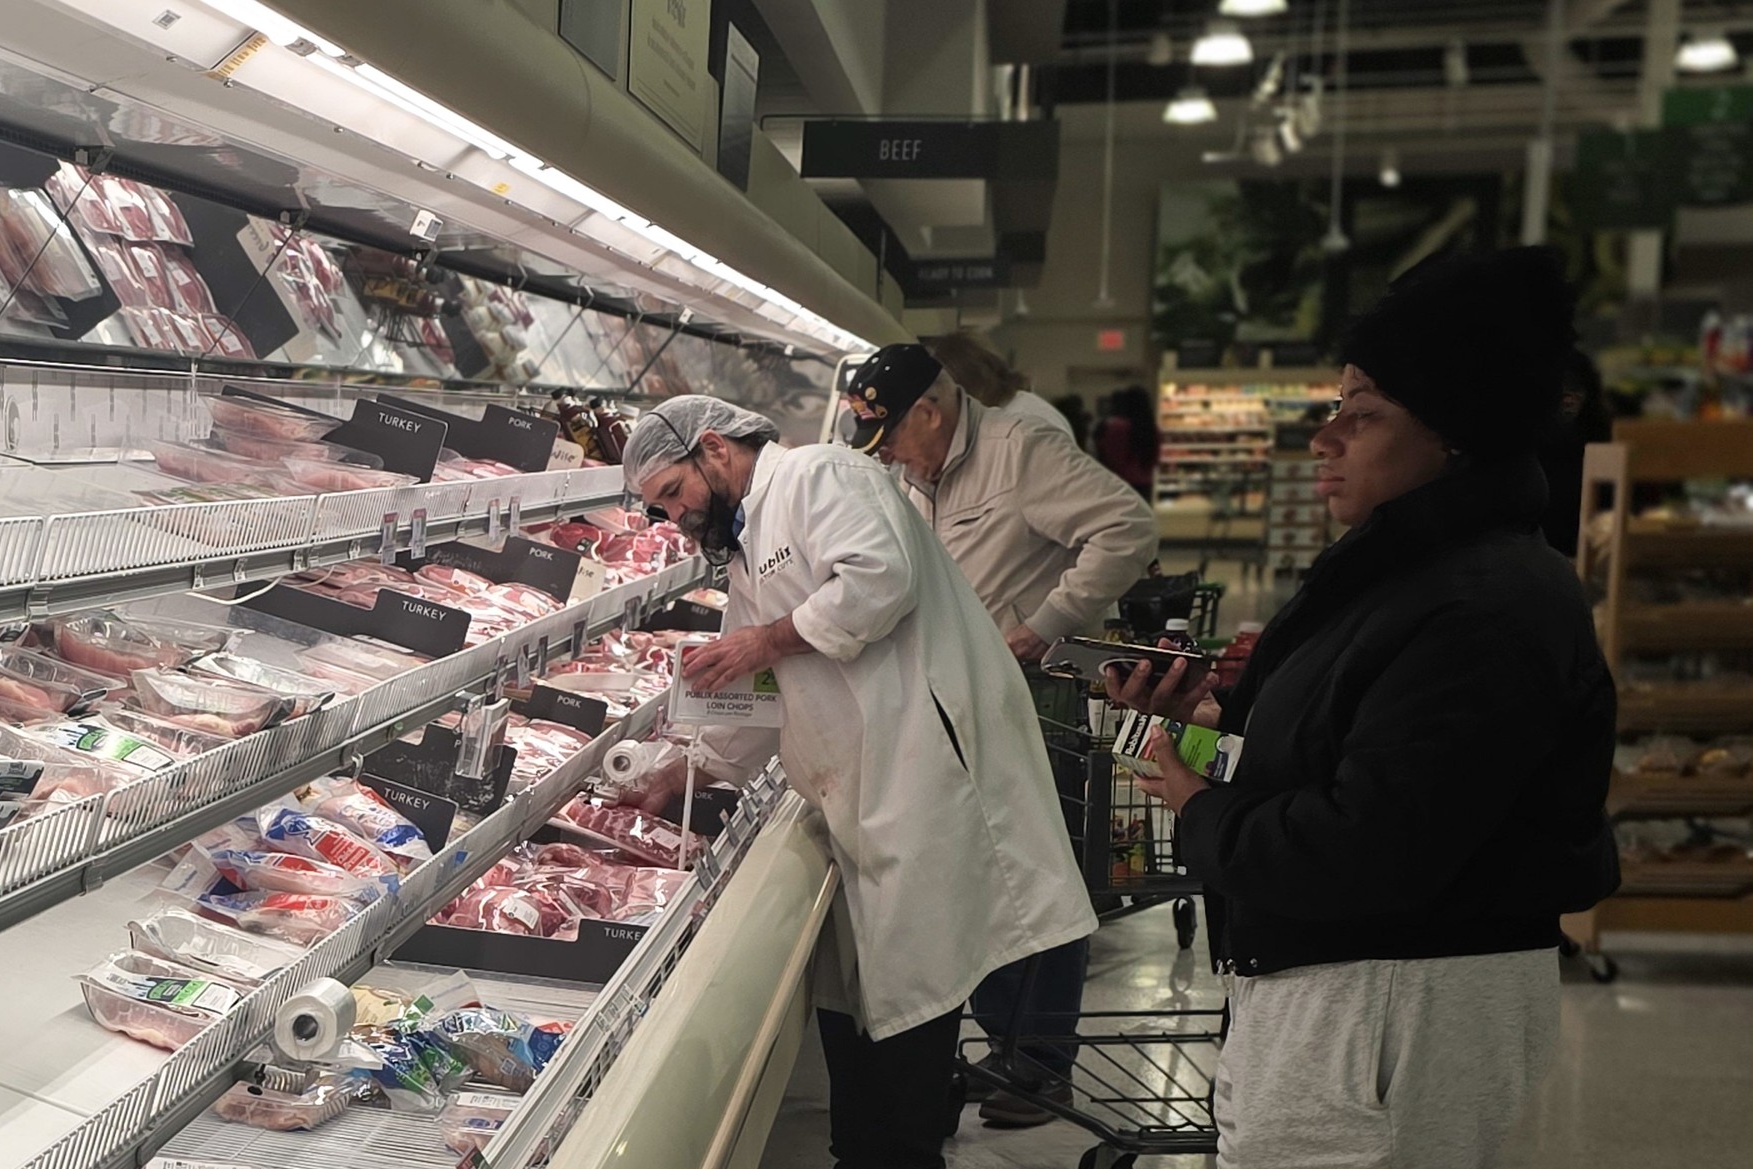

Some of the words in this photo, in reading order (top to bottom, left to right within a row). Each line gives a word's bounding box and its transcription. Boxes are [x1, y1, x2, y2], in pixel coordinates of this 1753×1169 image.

[879, 139, 923, 161] BEEF
[378, 411, 422, 434] TURKEY
[508, 416, 533, 431] PORK
[529, 546, 554, 561] PORK
[758, 545, 791, 575] ublix
[401, 599, 447, 623] TURKEY
[557, 694, 582, 709] PORK
[685, 690, 712, 700] PUBLIX
[713, 692, 754, 702] ASSORTED
[755, 694, 777, 702] PORK
[706, 702, 725, 710] LOIN
[726, 703, 754, 711] CHOPS
[384, 787, 430, 812] TURKEY
[694, 790, 714, 800] ORK
[604, 927, 643, 941] TURKE
